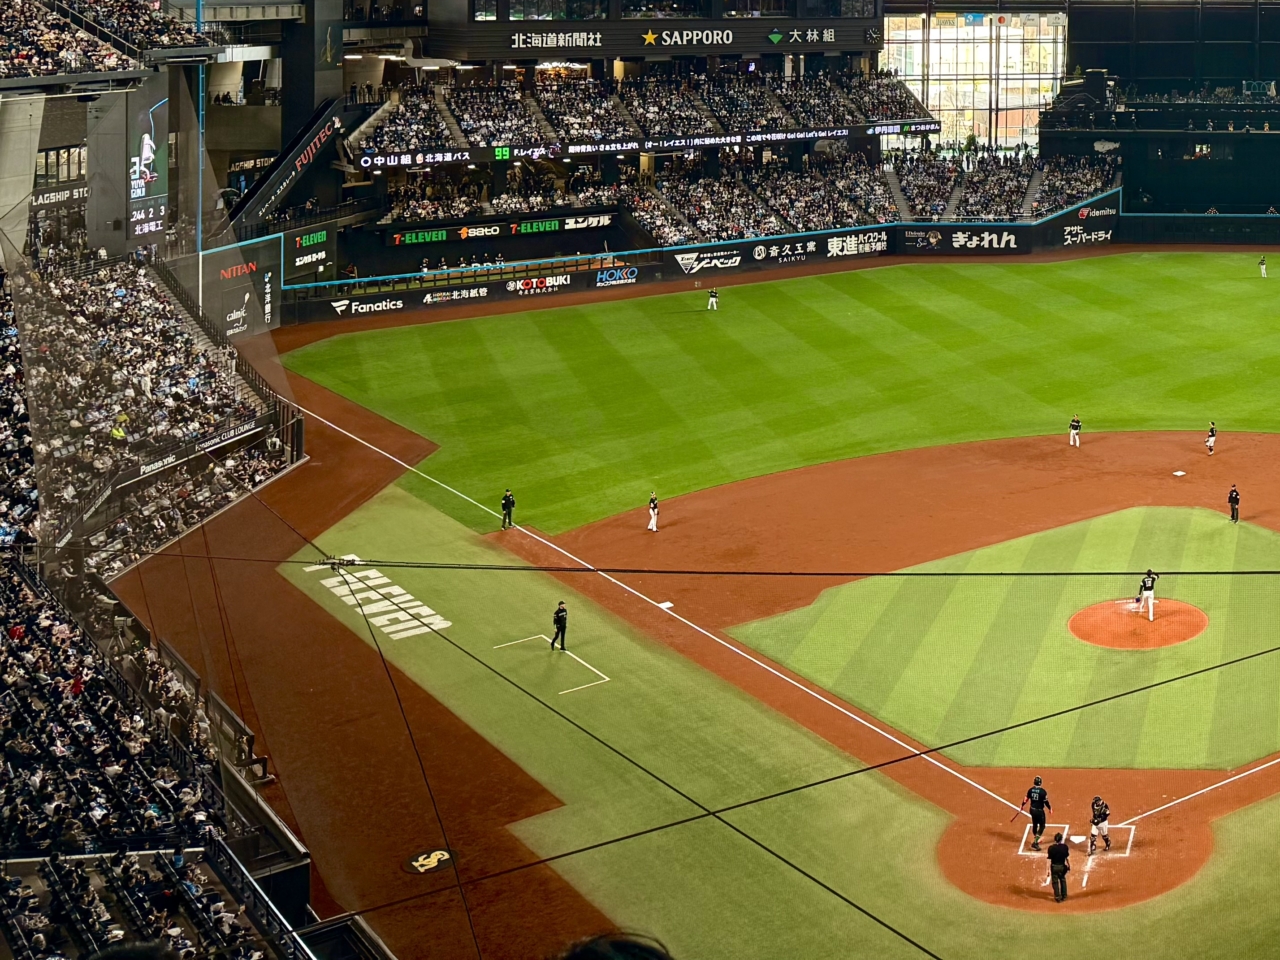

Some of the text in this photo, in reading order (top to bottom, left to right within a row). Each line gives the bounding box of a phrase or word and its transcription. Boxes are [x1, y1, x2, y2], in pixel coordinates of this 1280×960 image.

[511, 31, 602, 48] 北海道新聞社
[661, 29, 733, 45] SAPPORO
[789, 28, 835, 43] 大林組
[295, 121, 333, 172] FUJITEC
[495, 147, 510, 160] 99
[373, 154, 412, 166] 中山組
[424, 151, 470, 163] 北海道バス
[148, 207, 153, 218] 2
[160, 206, 165, 216] 3
[1089, 208, 1116, 218] idemitsu
[468, 226, 500, 237] sato
[858, 231, 887, 244] ハイスクール
[1064, 226, 1083, 235] アサヒ
[1064, 230, 1113, 246] スーパードライ
[827, 236, 858, 257] 東進
[951, 231, 1018, 249] ぎょれん
[688, 256, 742, 274] ジーベック
[778, 255, 806, 263] SAIKYU
[220, 261, 257, 280] NITTAN
[516, 275, 570, 290] KOTOBUKI
[451, 287, 488, 300] 北海紙管
[351, 298, 403, 314] Fanatics
